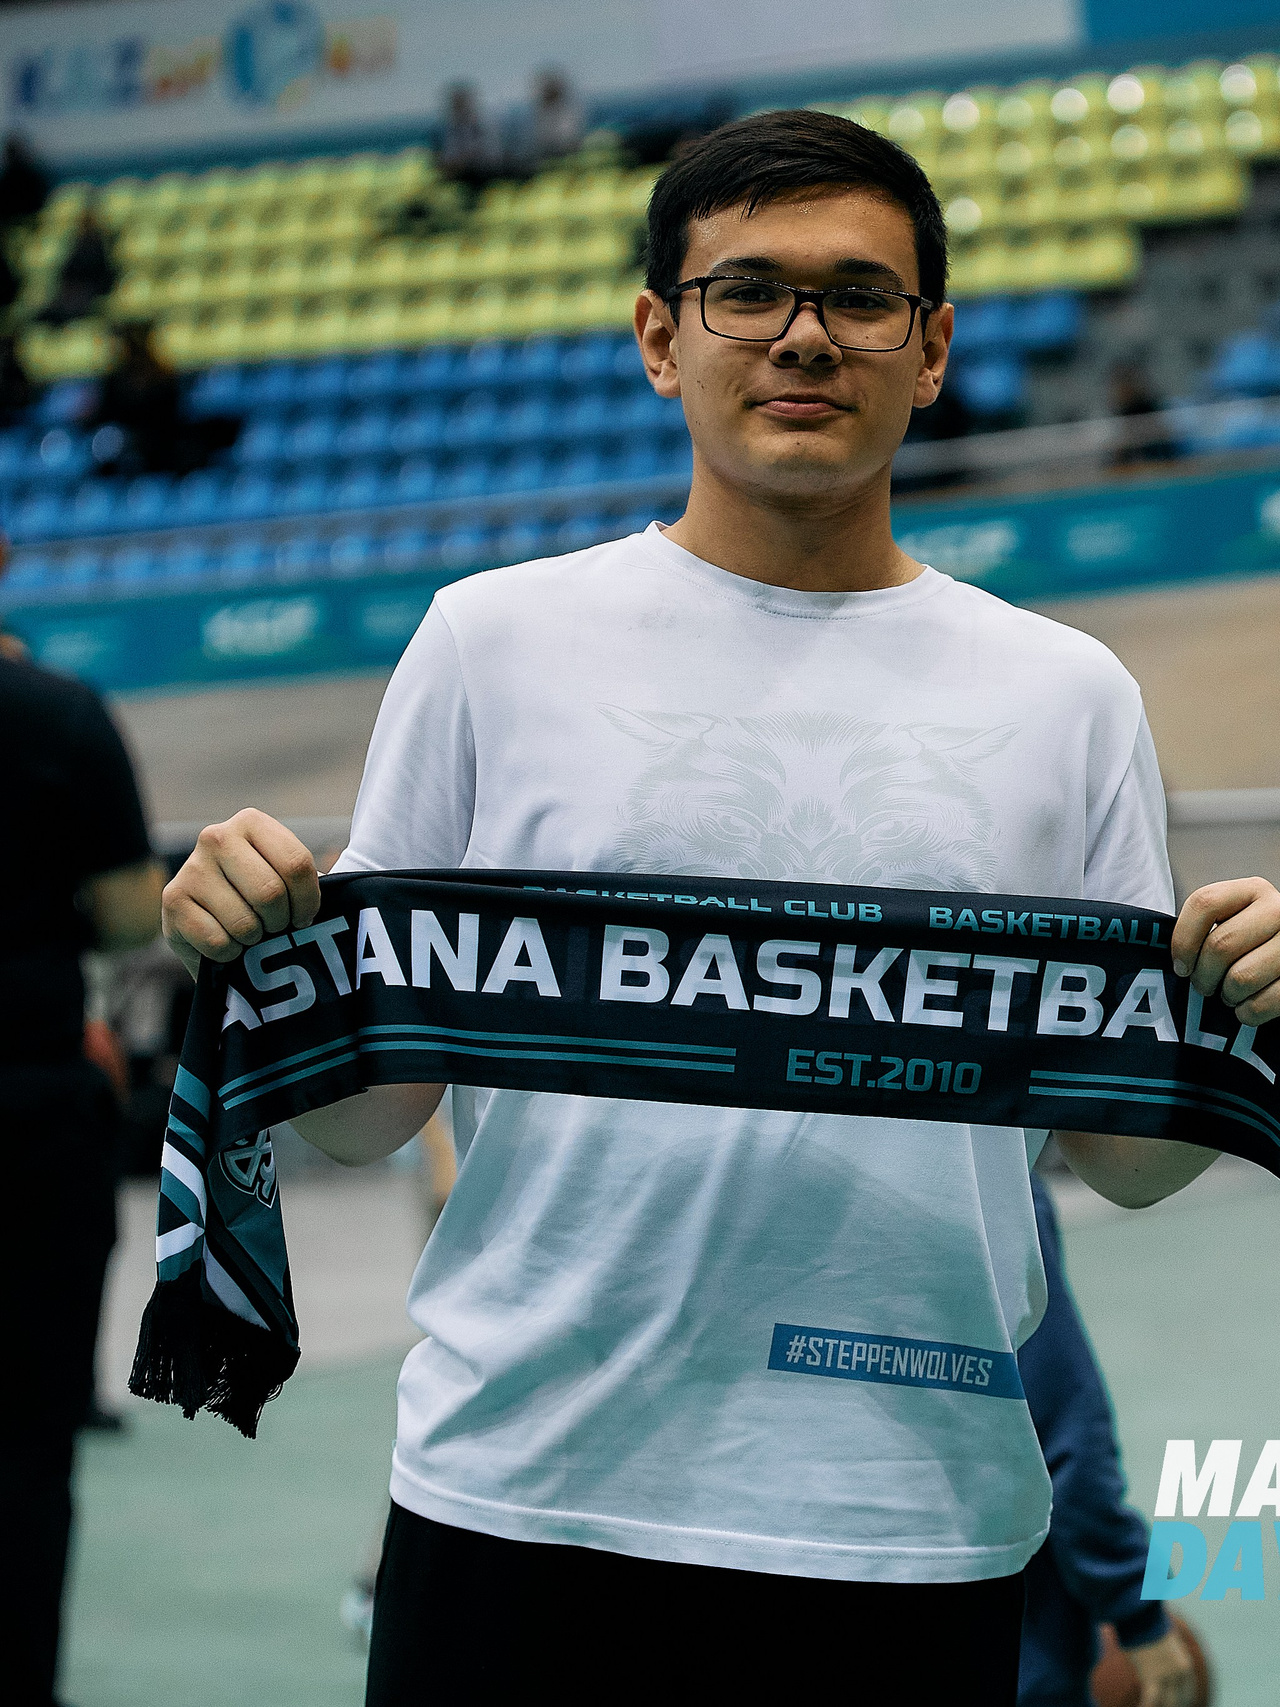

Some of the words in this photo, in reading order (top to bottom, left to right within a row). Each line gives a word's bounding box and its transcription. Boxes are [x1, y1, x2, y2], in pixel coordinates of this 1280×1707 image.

[783, 899, 883, 923] CLUB
[929, 906, 1169, 949] BASKETBALL
[220, 906, 562, 1034] ASTANA
[786, 1048, 983, 1095] EST.2010
[786, 1335, 993, 1387] #STEPPENWOLVES
